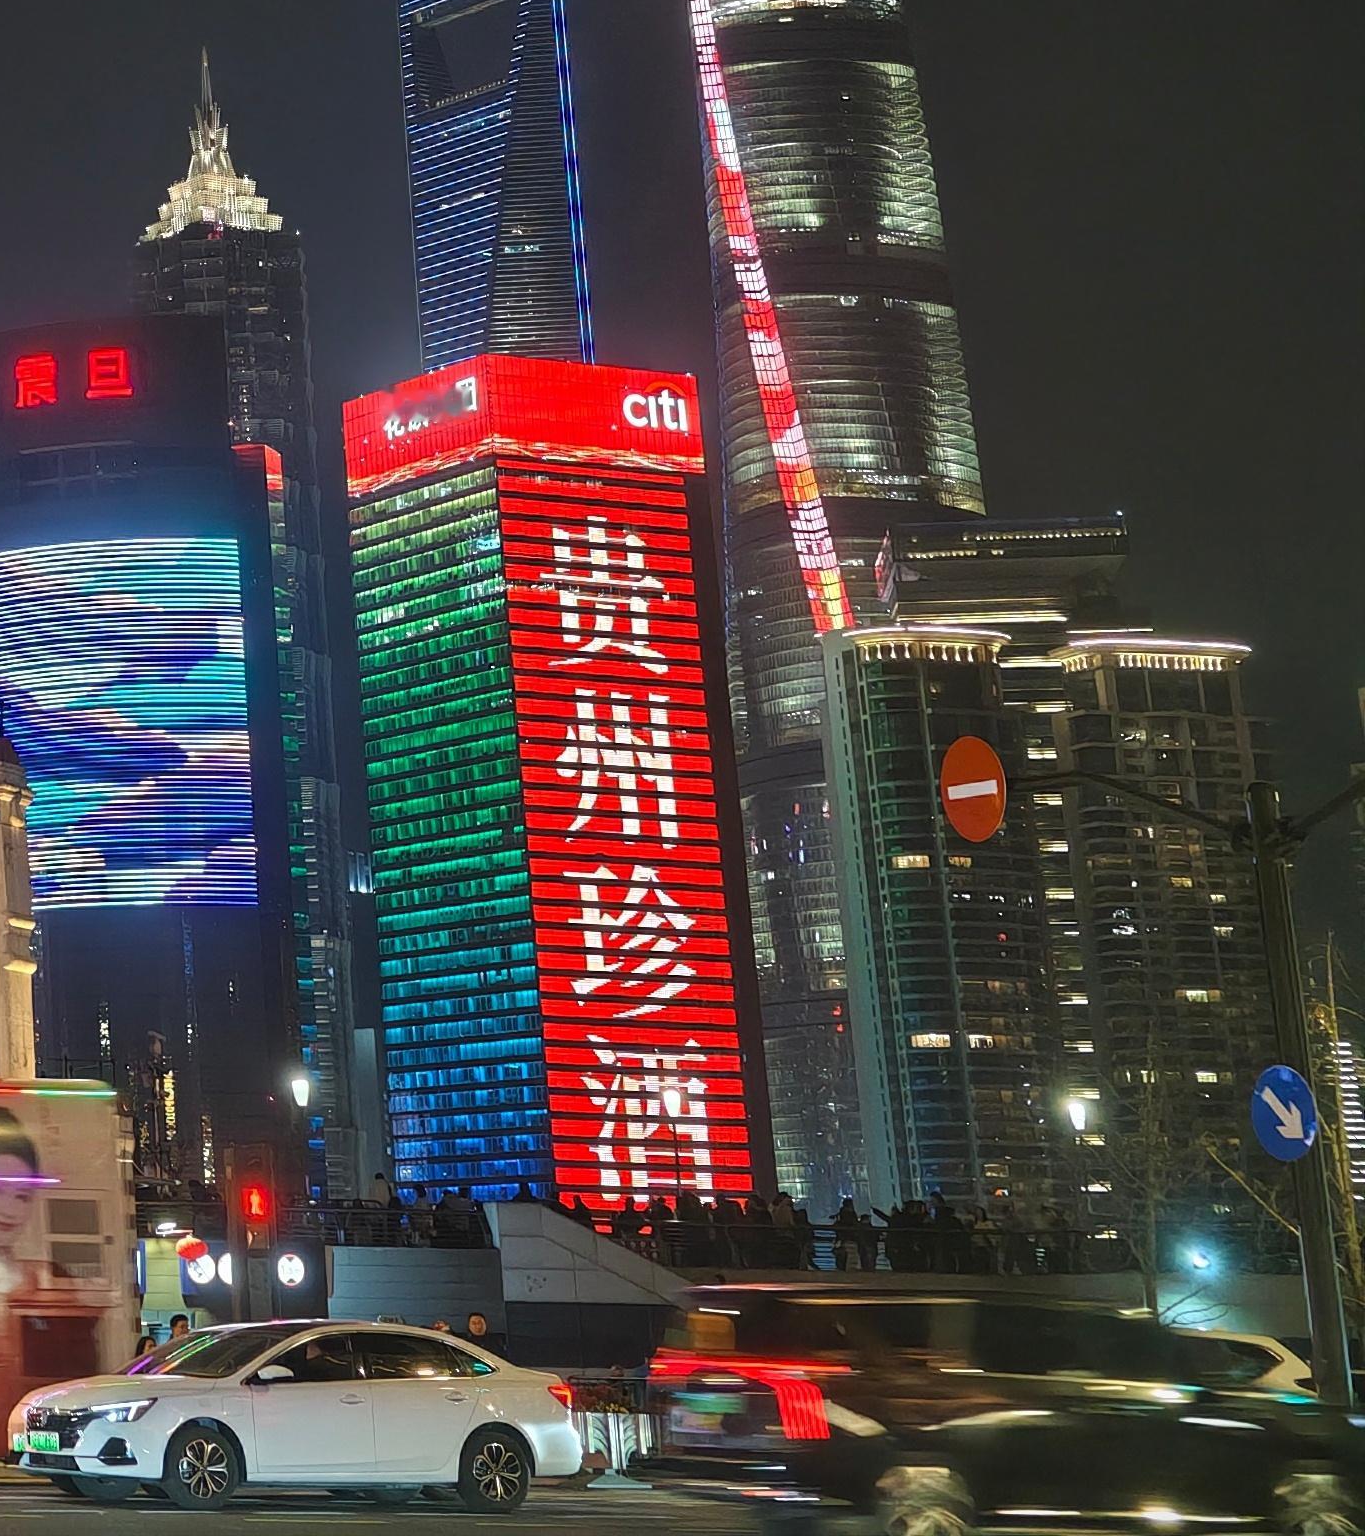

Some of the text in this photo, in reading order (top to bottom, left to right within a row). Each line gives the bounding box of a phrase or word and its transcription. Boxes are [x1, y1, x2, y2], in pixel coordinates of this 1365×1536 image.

[14, 347, 134, 409] 震旦
[622, 389, 688, 432] citi
[540, 516, 715, 1204] 贵州珍酒
